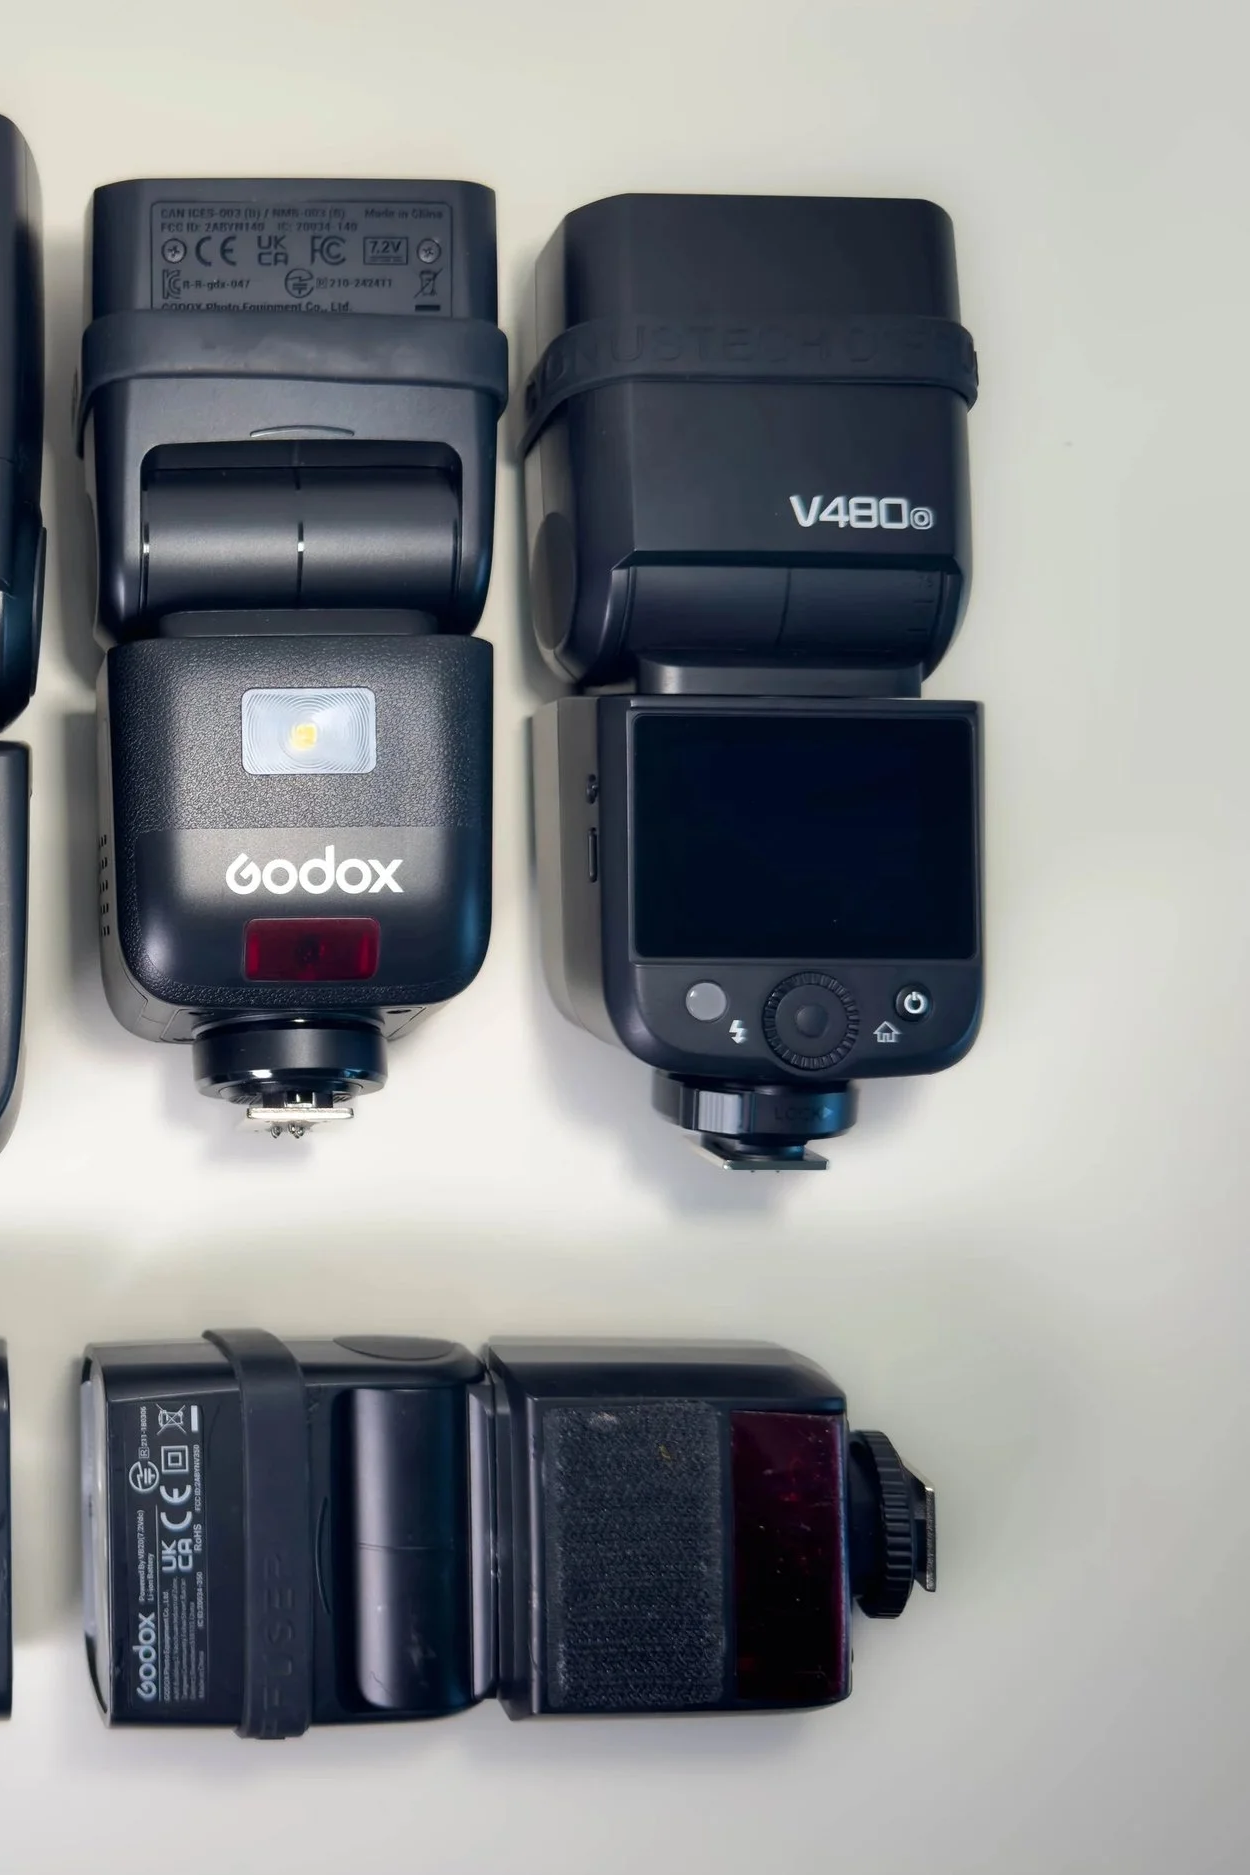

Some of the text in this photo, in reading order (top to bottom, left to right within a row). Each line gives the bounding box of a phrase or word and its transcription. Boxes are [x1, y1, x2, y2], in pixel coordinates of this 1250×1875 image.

[369, 240, 403, 255] 7.2V
[225, 844, 404, 895] Godox
[193, 1524, 202, 1551] RoHS
[136, 1560, 147, 1571] By
[131, 1612, 158, 1702] Godox
